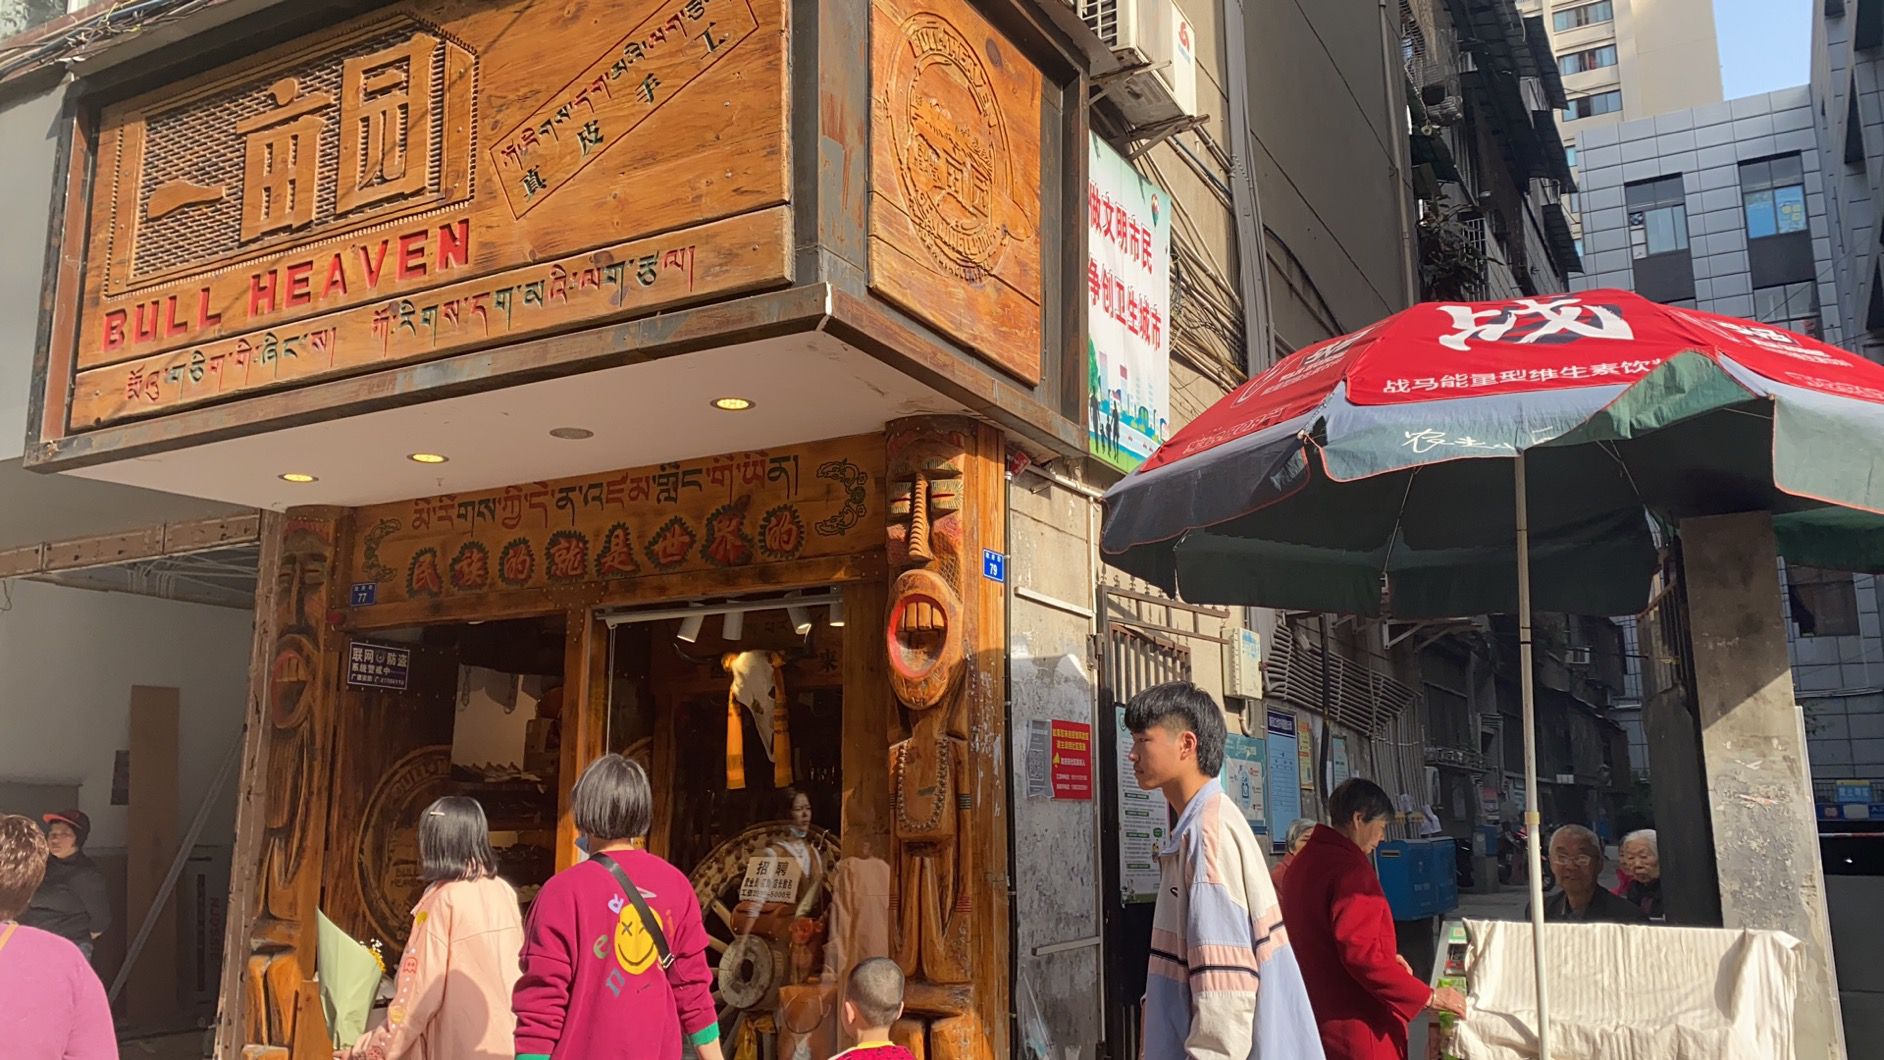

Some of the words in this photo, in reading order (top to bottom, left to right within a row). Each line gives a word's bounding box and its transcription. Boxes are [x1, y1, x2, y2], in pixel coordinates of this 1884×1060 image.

[522, 22, 729, 201] 真皮手工
[1088, 179, 1153, 275] 做文明市民
[101, 287, 223, 353] BULL
[247, 218, 470, 319] HEAVEN
[1088, 256, 1162, 352] 争创卫生城市
[1382, 358, 1663, 395] 战马能量型维生素饮
[412, 510, 799, 592] 民族的就是世界的
[989, 562, 998, 576] 79
[358, 592, 368, 603] 77
[756, 860, 789, 877] 招聘
